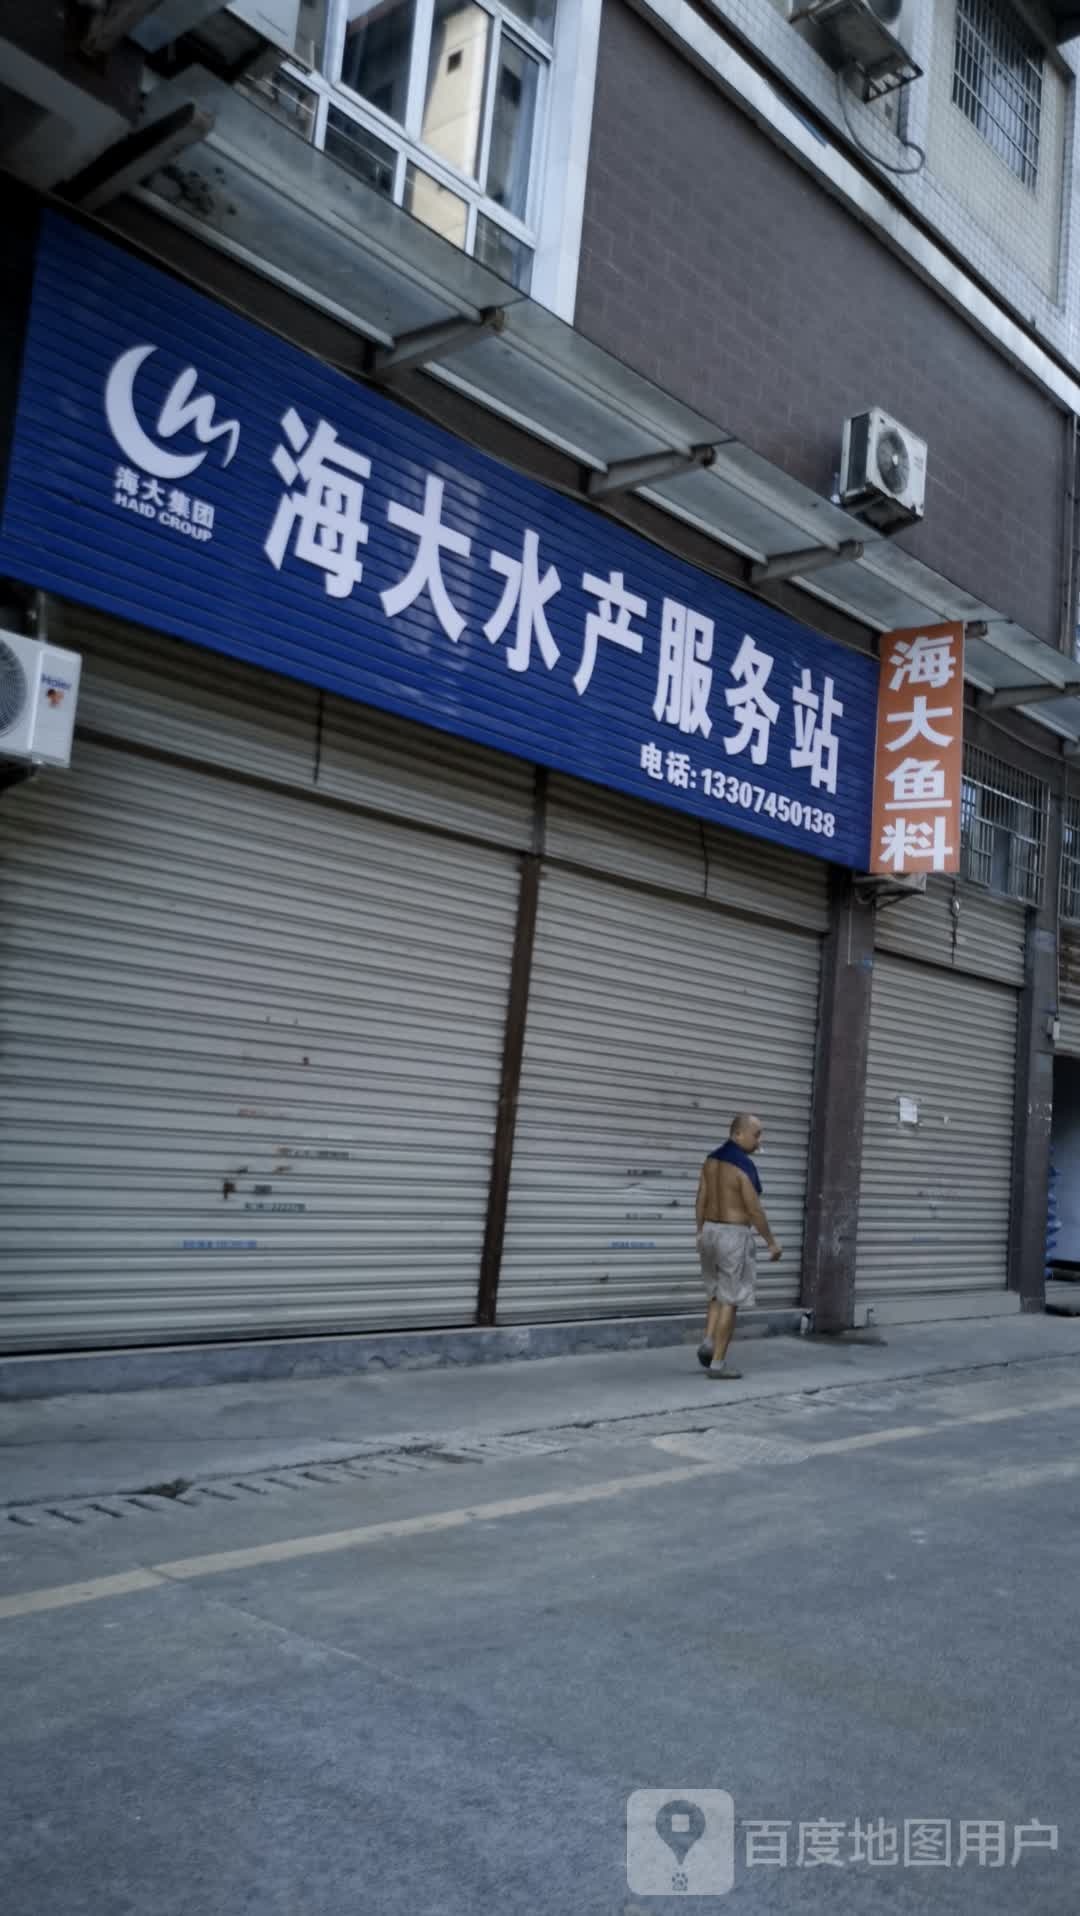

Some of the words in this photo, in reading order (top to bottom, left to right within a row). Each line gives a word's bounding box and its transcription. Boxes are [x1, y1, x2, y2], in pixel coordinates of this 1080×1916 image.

[114, 465, 216, 530] 海大集团
[114, 491, 156, 519] HAID
[264, 406, 846, 796] 海大水产服务站
[879, 635, 957, 871] 海大鱼料
